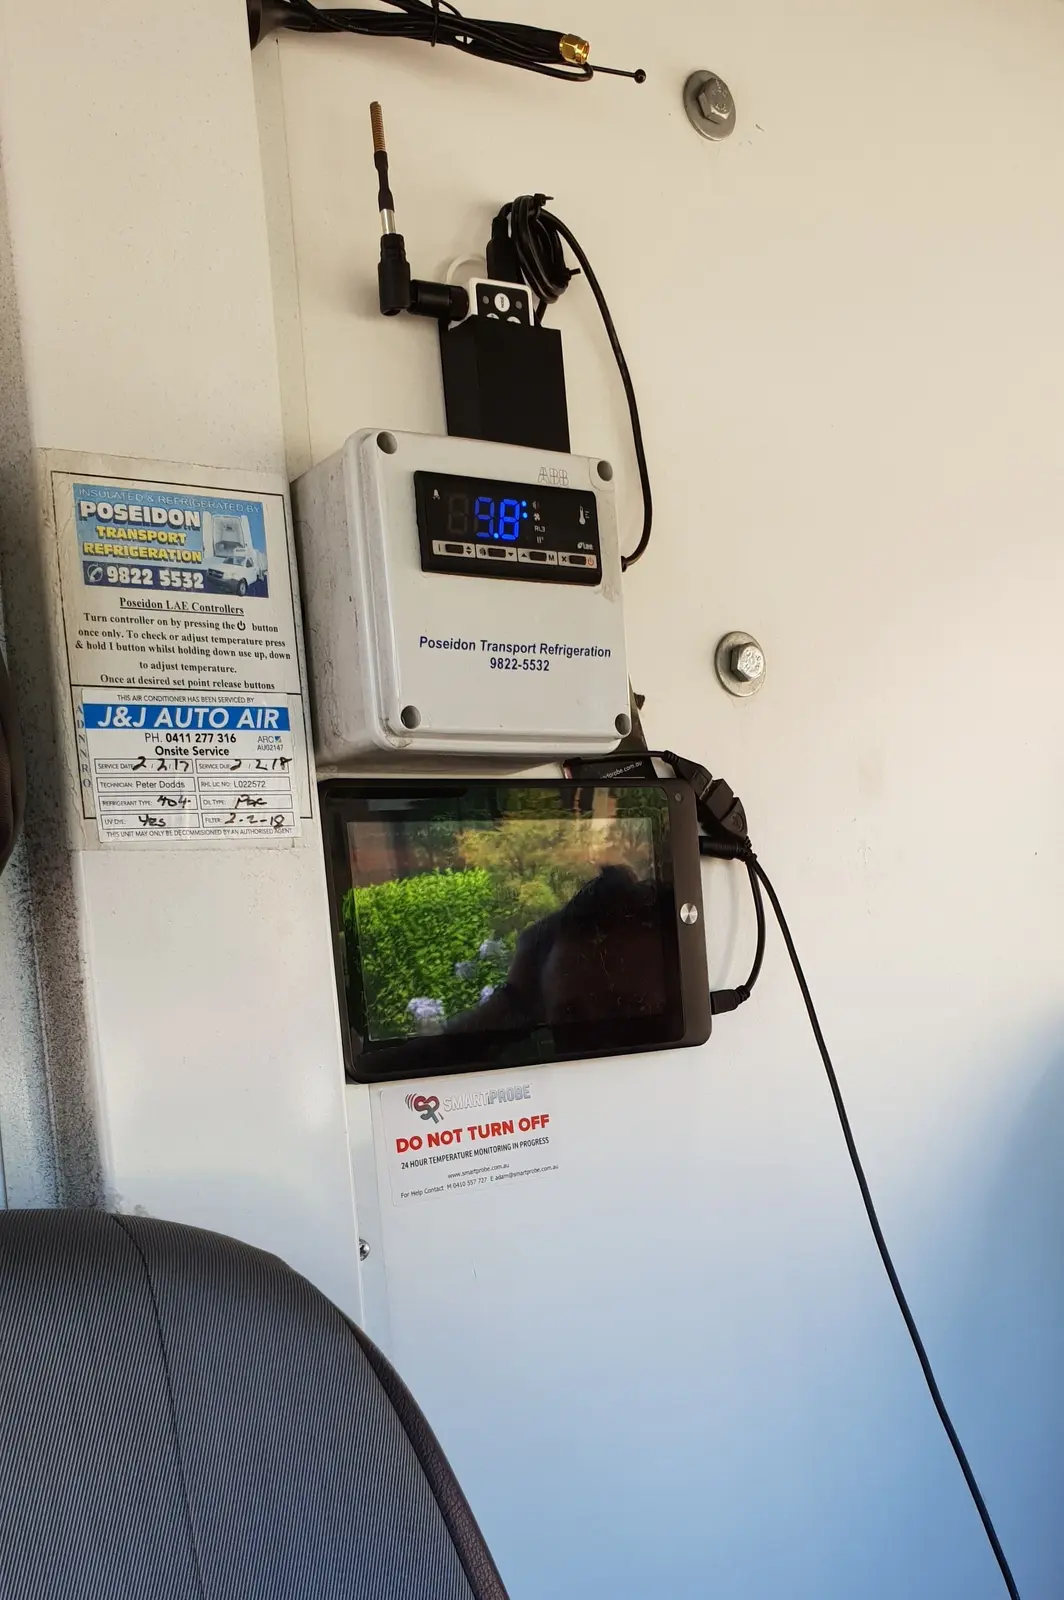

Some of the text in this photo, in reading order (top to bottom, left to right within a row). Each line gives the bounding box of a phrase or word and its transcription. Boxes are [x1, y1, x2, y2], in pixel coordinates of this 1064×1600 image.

[538, 467, 569, 486] ABB
[78, 489, 260, 513] INSULATED & REFRIGERATED BY
[80, 500, 200, 528] POSEIDON
[96, 526, 187, 544] TRANSPORT
[83, 542, 202, 562] REFRIGERATION
[106, 565, 204, 589] 9822 5532
[119, 597, 244, 615] Poseidon LAE Controllers
[83, 612, 279, 633] Turn controller on by pressing the button
[78, 629, 99, 637] once
[101, 629, 124, 639] only.
[126, 630, 139, 639] To
[141, 631, 167, 641] check
[181, 633, 209, 643] adjust
[211, 635, 263, 647] temperature
[265, 639, 286, 648] press
[419, 636, 611, 659] Poseidon Transport Refrigeration
[75, 641, 84, 649] &
[86, 641, 106, 650] hold
[116, 642, 146, 653] button
[148, 644, 176, 654] whilst
[178, 646, 211, 656] holding
[212, 647, 236, 656] down
[254, 651, 268, 660] up,
[269, 651, 291, 660] down
[150, 661, 178, 671] adjust
[181, 663, 237, 674] temperature.
[490, 657, 550, 672] 9822-5532
[100, 674, 275, 690] Once at desired set point release buttons
[217, 696, 245, 704] SERVICED
[97, 706, 280, 729] J&J AUTO AIR
[145, 733, 237, 743] PH. 0411 277 316
[155, 746, 230, 756] Onsite Service
[234, 780, 266, 788] L022572
[396, 1114, 550, 1153] DO NOT TURN OFF
[401, 1162, 409, 1170] 24
[409, 1157, 428, 1168] HOUR
[429, 1150, 473, 1165] TEMPERATURE
[473, 1143, 512, 1158] MONITORING
[519, 1136, 549, 1148] PROGRESS
[411, 1189, 424, 1197] Help
[424, 1185, 444, 1194] Contact
[452, 1181, 466, 1189] 0410
[478, 1177, 487, 1185] 727
[494, 1164, 559, 1181] adam@smartprobe.com.au
[448, 1163, 509, 1179] www.smartprobe.com.au
